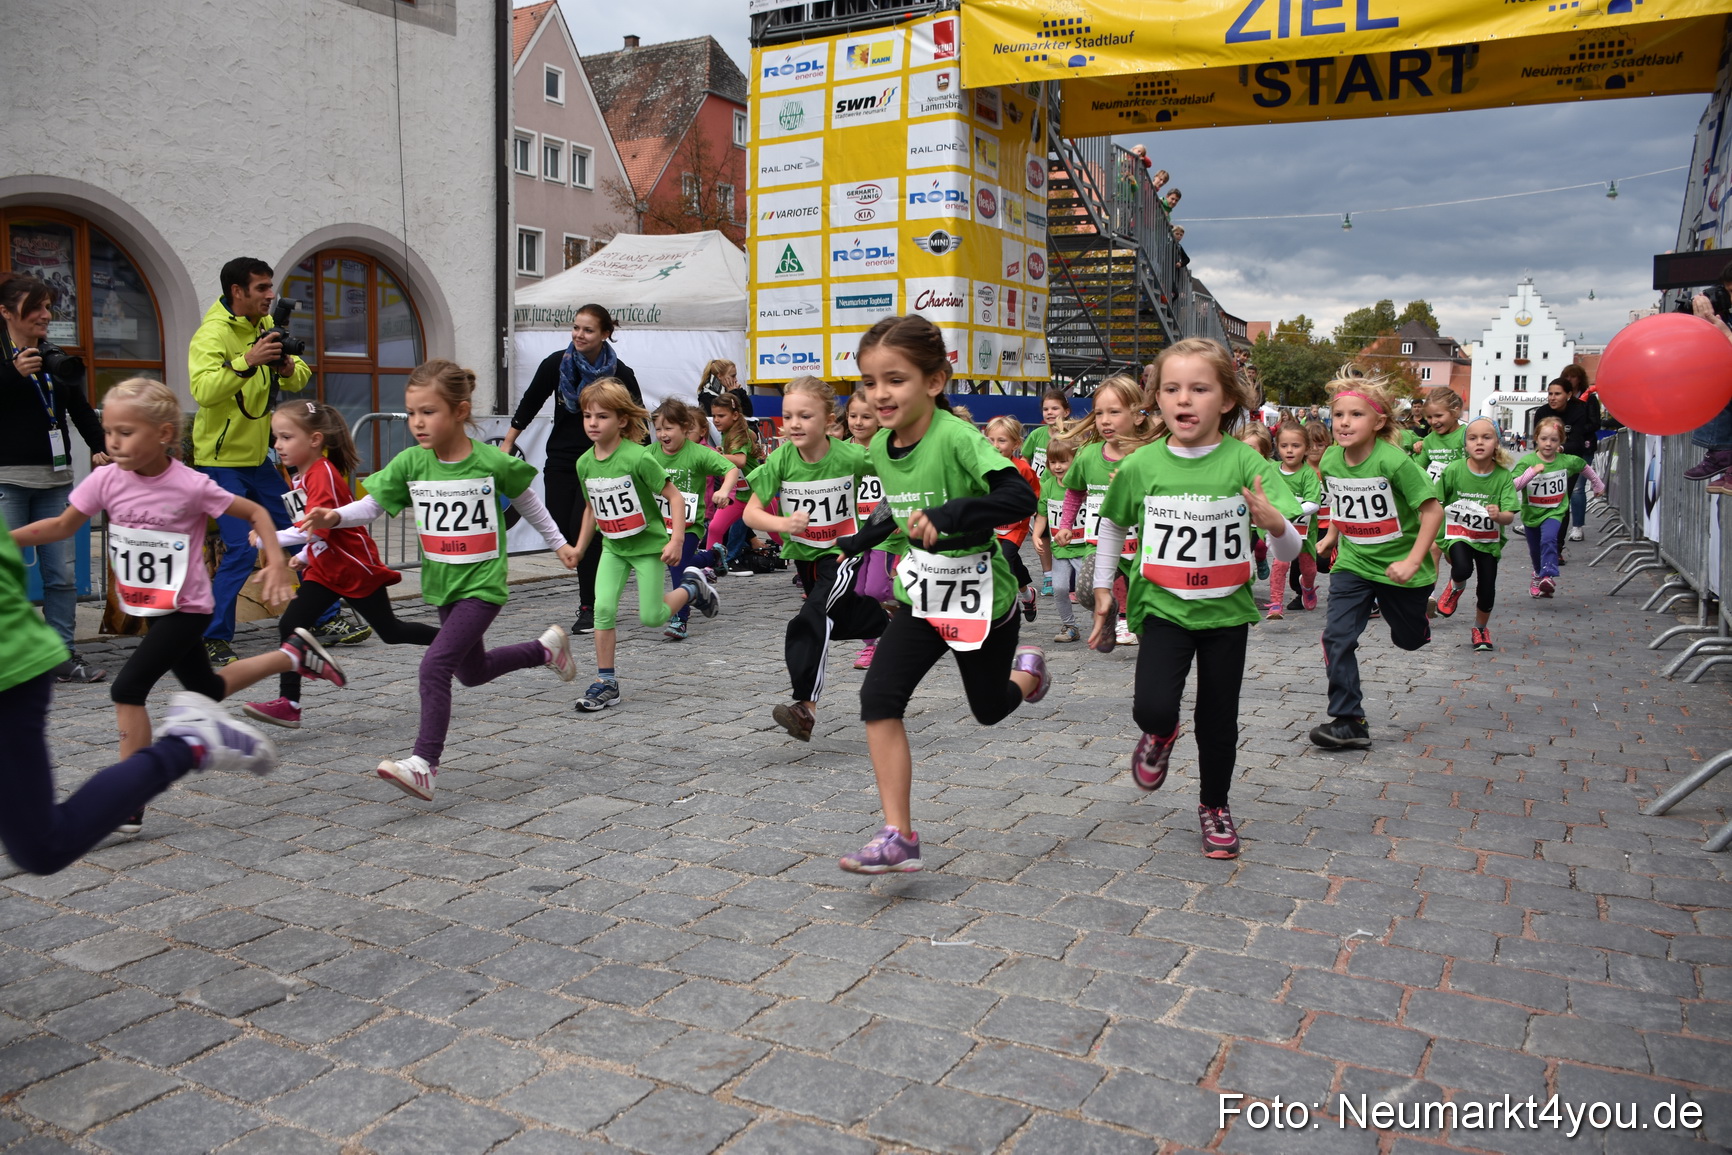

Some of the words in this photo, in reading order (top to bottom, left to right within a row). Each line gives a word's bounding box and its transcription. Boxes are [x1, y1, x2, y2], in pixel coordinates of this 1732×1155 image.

[1225, 0, 1398, 44] ZIEL
[993, 41, 1070, 56] Neumarkter
[1074, 30, 1134, 49] Stadtlauf
[872, 57, 890, 65] KANN
[1521, 63, 1608, 79] Neumarkter
[1611, 51, 1684, 69] Stadtlauf
[1251, 45, 1479, 108] START
[927, 93, 960, 102] Neumarkter
[1091, 96, 1155, 112] Neumarkter
[1160, 92, 1215, 106] Stadtlauf
[835, 96, 877, 114] swn
[776, 207, 819, 219] VARIOTEC
[858, 211, 872, 219] KIA
[930, 239, 949, 247] MINI
[839, 299, 868, 307] Neumarkter
[411, 488, 434, 497] PARTL
[436, 488, 478, 498] Neumarkt
[805, 486, 841, 495] Neumarkt
[1532, 479, 1563, 495] 7130
[590, 492, 634, 516] 7415
[787, 494, 848, 522] 7214
[419, 499, 488, 531] 7224
[1148, 507, 1181, 519] PARTL
[1184, 510, 1233, 522] Neumarkt
[1451, 510, 1494, 530] 7420
[805, 529, 836, 541] Sophia
[1346, 525, 1381, 535] Johanna
[124, 537, 170, 549] Neumarkt
[440, 540, 467, 552] Julia
[1155, 522, 1241, 562] 7215
[920, 563, 972, 575] Neumarkt
[1186, 573, 1208, 586] Ida
[905, 570, 980, 614] 7175
